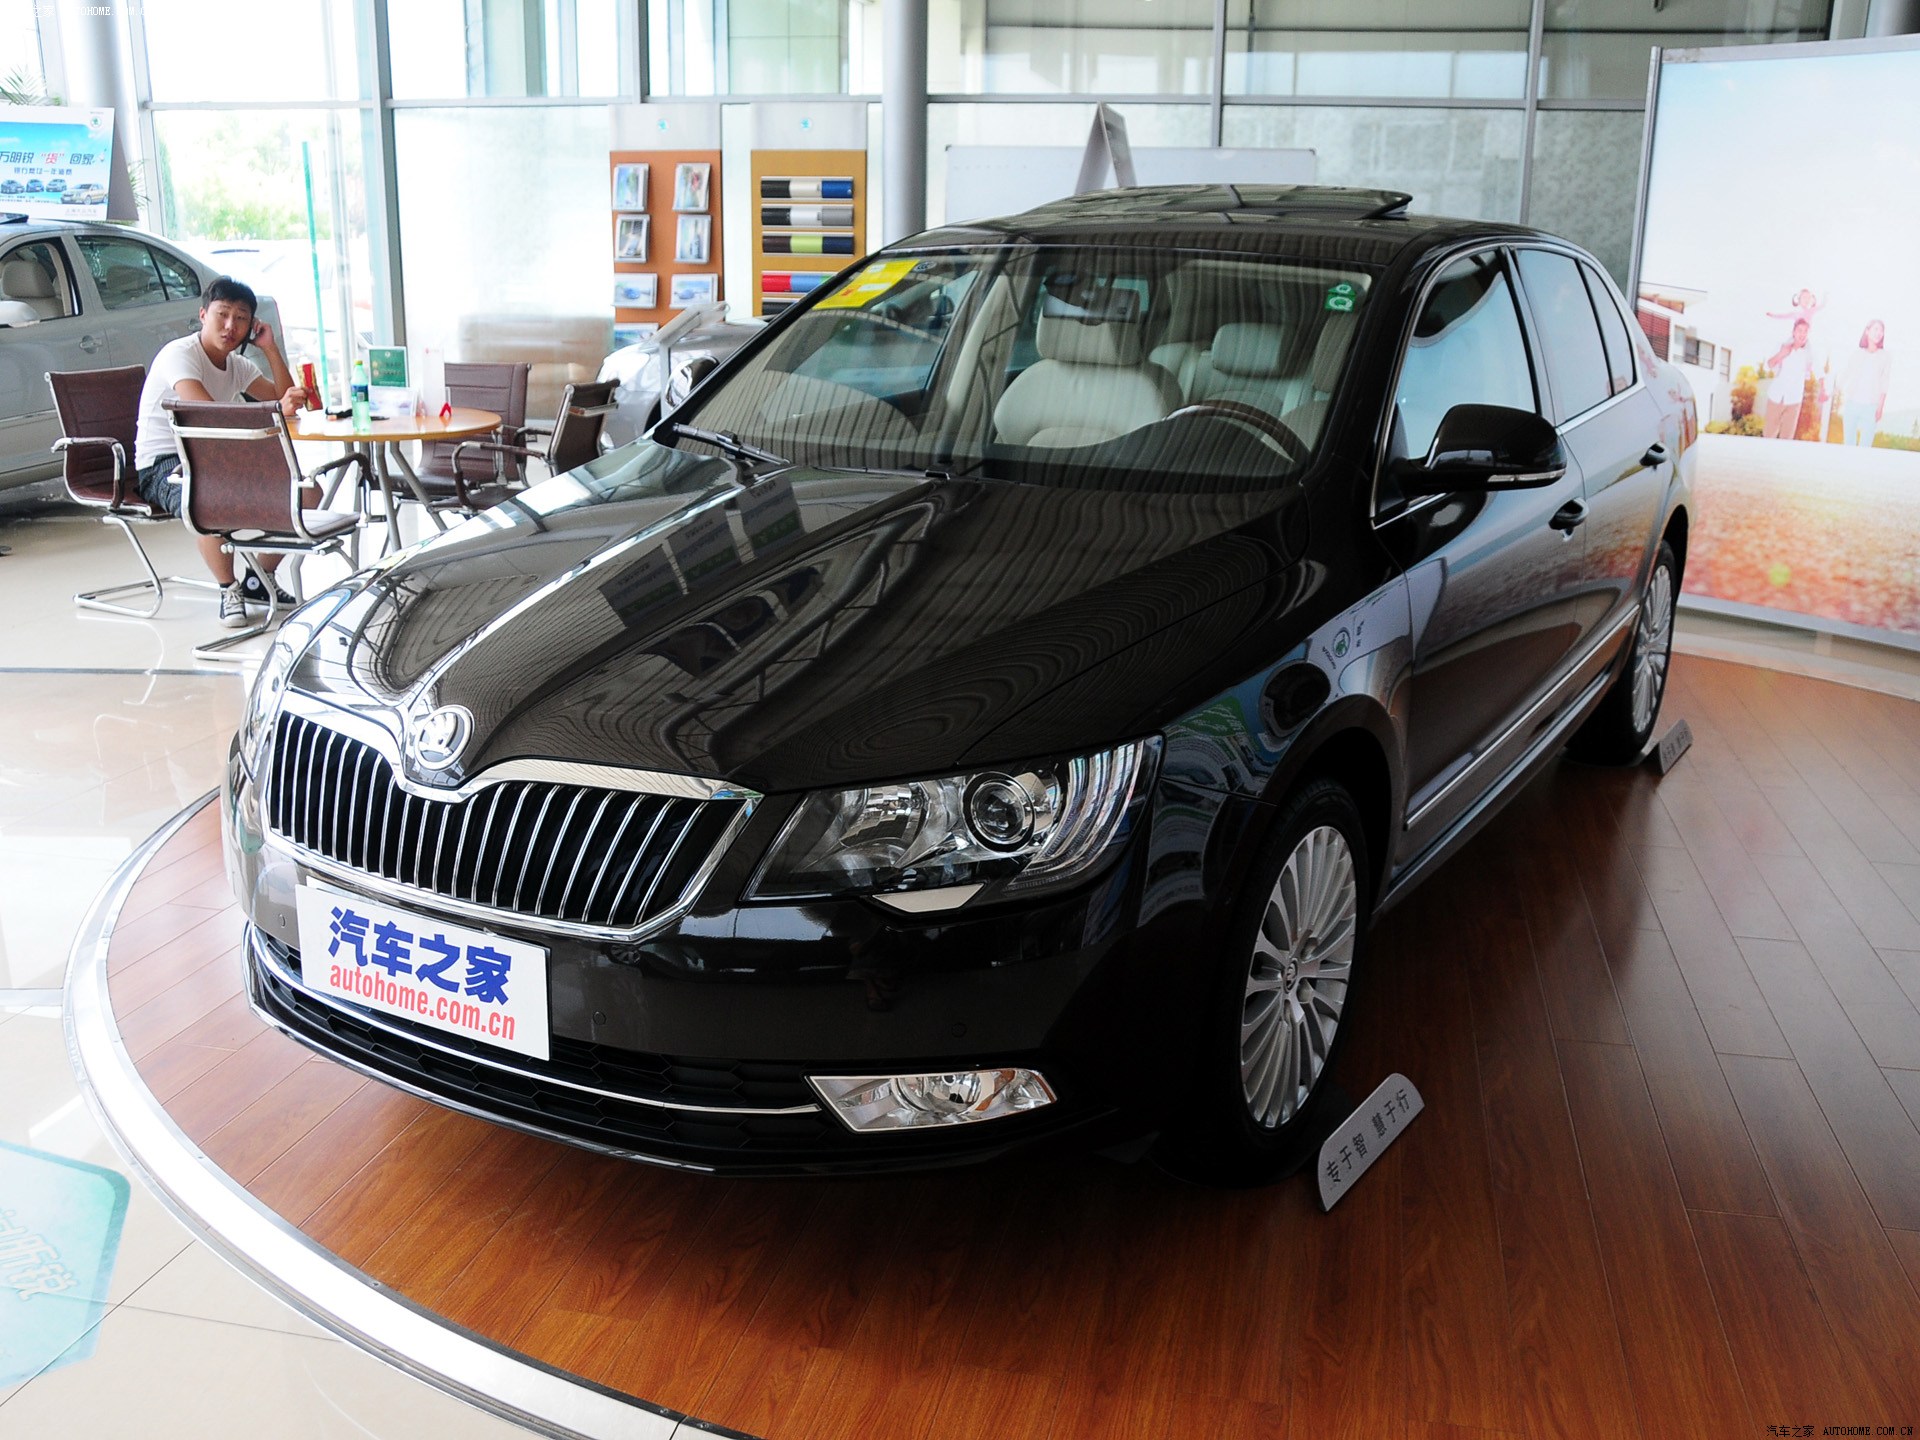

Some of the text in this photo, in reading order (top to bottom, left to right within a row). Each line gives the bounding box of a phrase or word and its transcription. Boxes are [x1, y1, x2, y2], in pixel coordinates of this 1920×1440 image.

[328, 907, 512, 1006] 汽车之家
[330, 965, 515, 1041] autohome.com.cn
